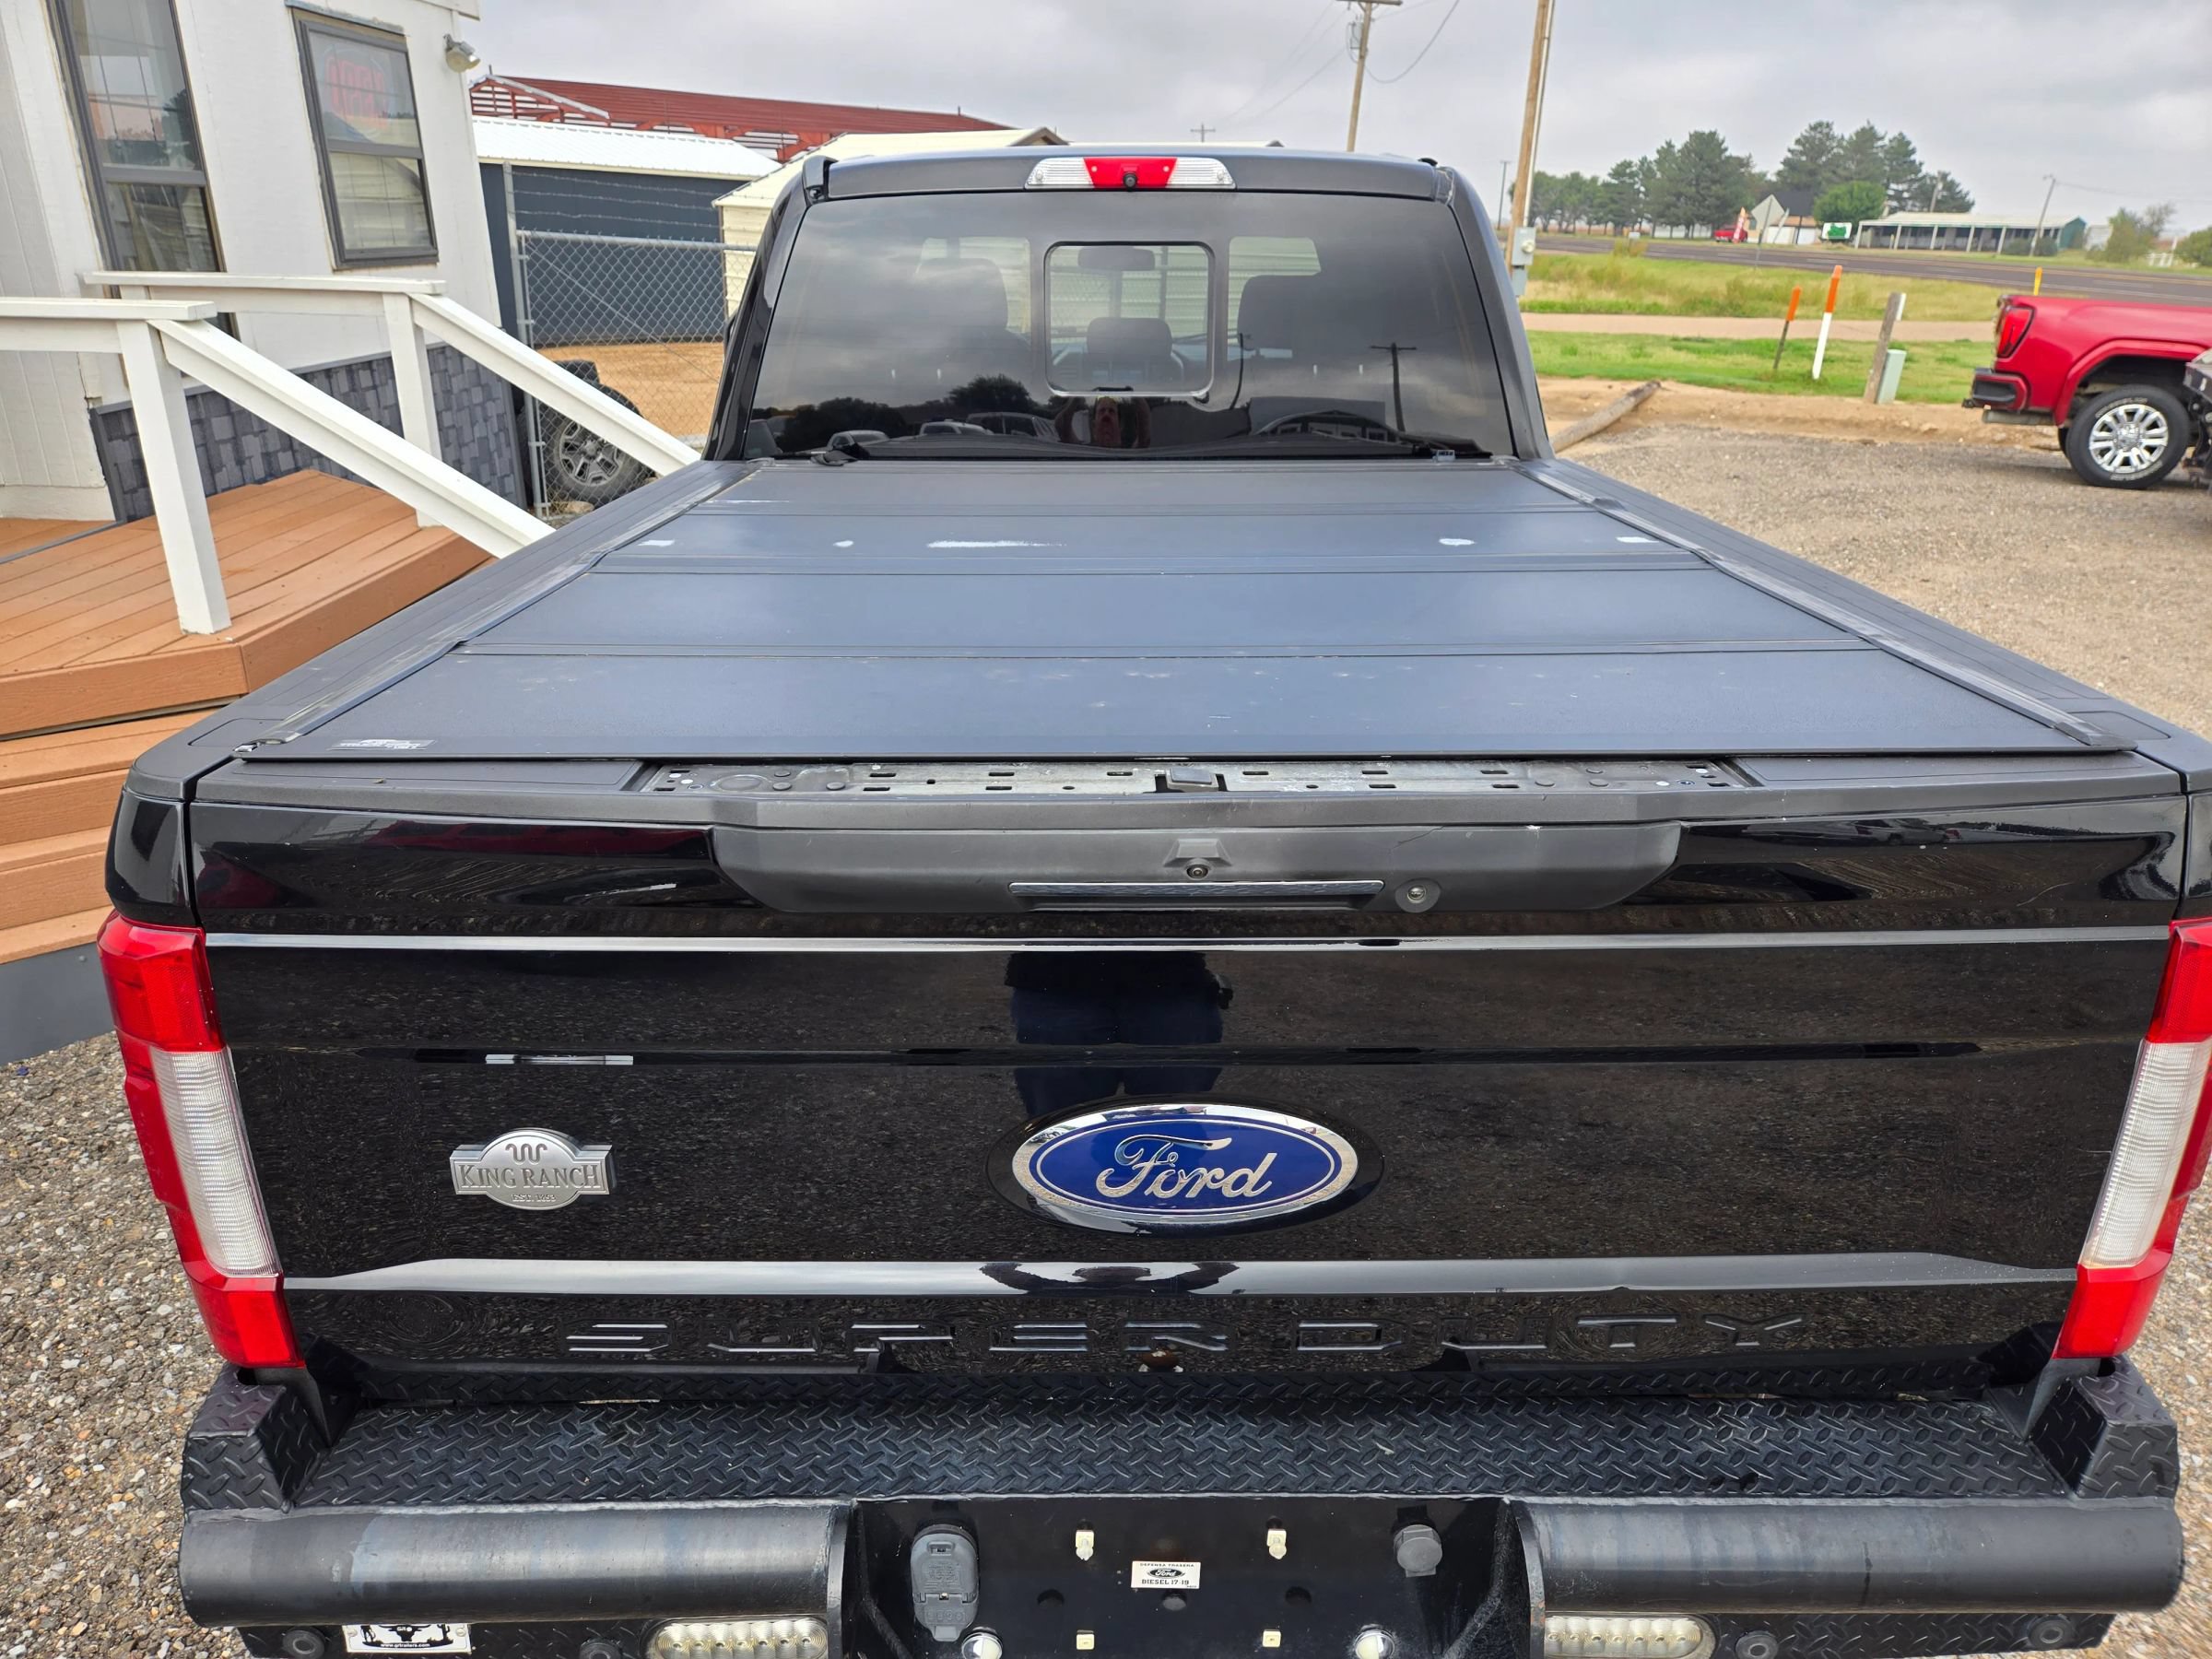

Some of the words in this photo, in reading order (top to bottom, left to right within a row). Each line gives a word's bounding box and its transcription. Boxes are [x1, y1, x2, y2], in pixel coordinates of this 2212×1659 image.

[459, 1164, 516, 1188] KING
[523, 1164, 601, 1188] RANCH
[1095, 1134, 1277, 1198] Ford
[562, 1319, 1230, 1353] SUPER
[1295, 1312, 1805, 1352] DUTY
[1155, 1569, 1177, 1577] Ford
